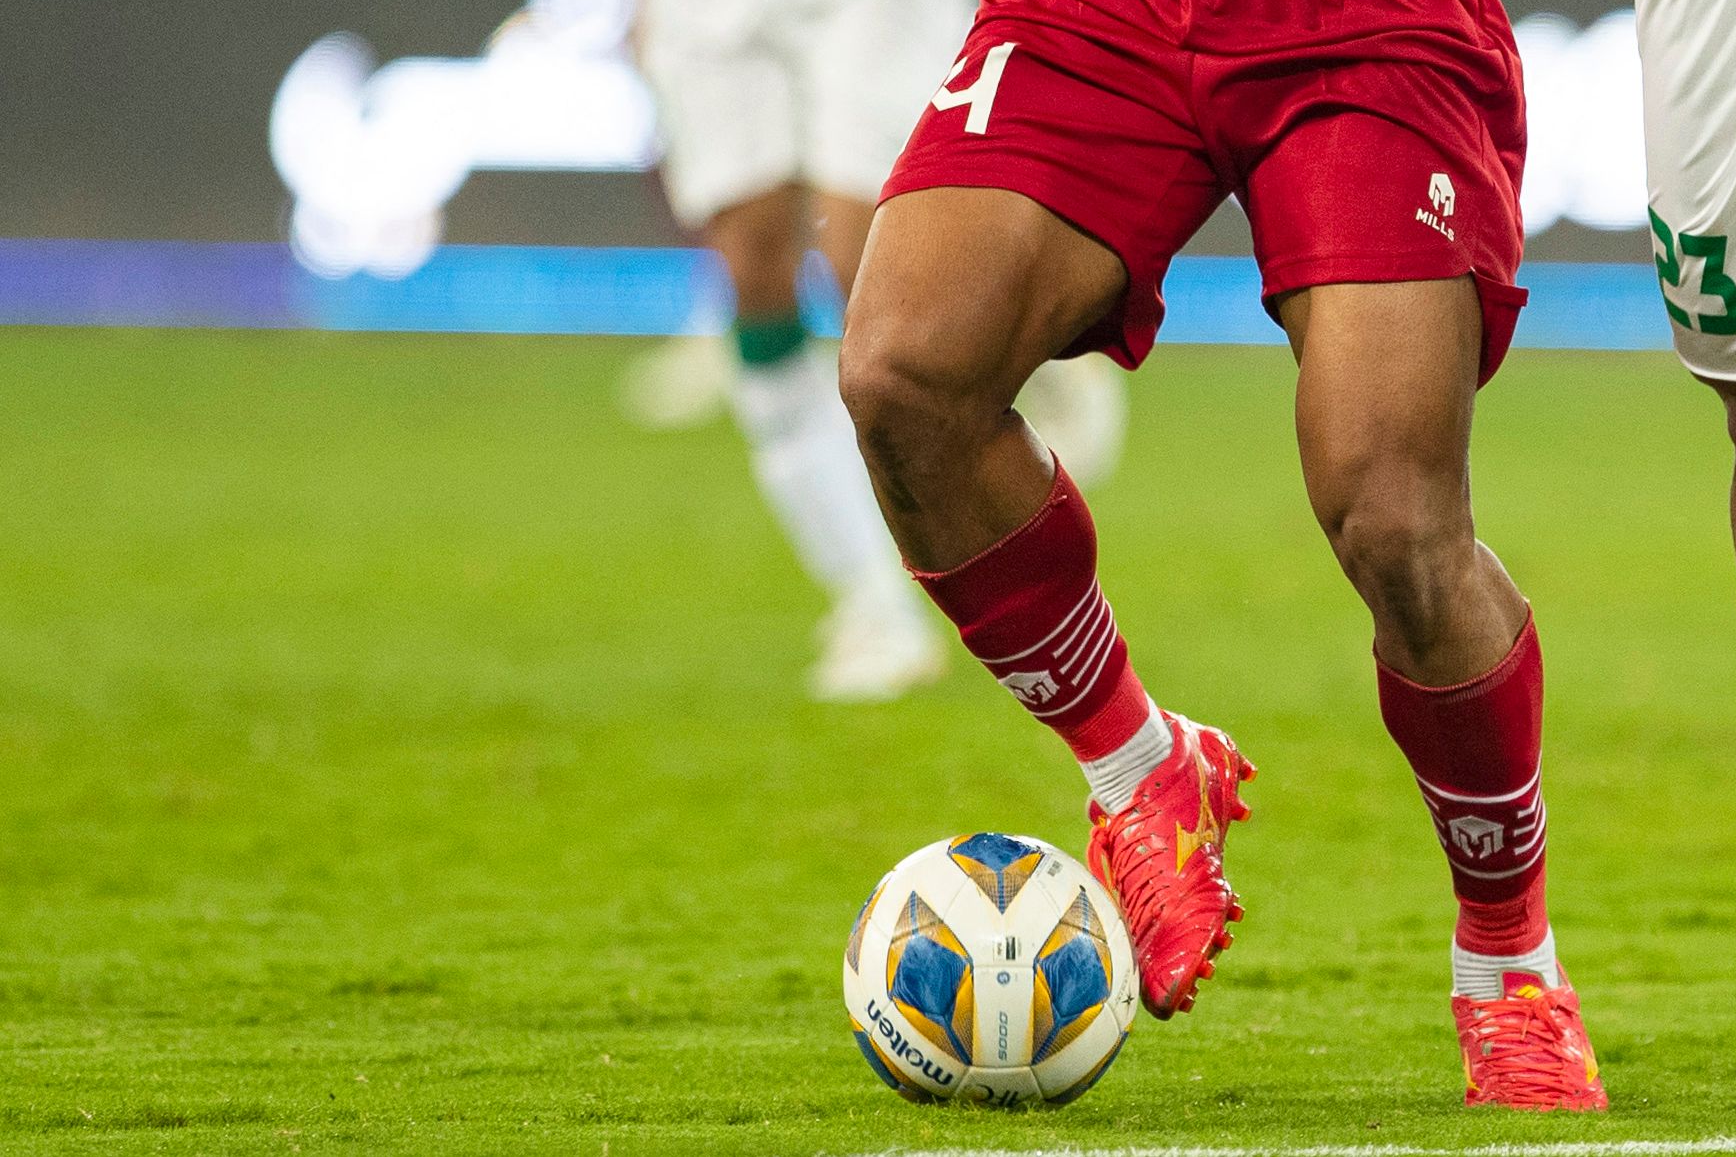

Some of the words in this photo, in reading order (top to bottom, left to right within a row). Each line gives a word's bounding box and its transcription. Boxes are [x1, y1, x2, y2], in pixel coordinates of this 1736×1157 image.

[1415, 208, 1455, 242] MILLS
[867, 999, 954, 1086] molten
[998, 1010, 1008, 1061] 5000
